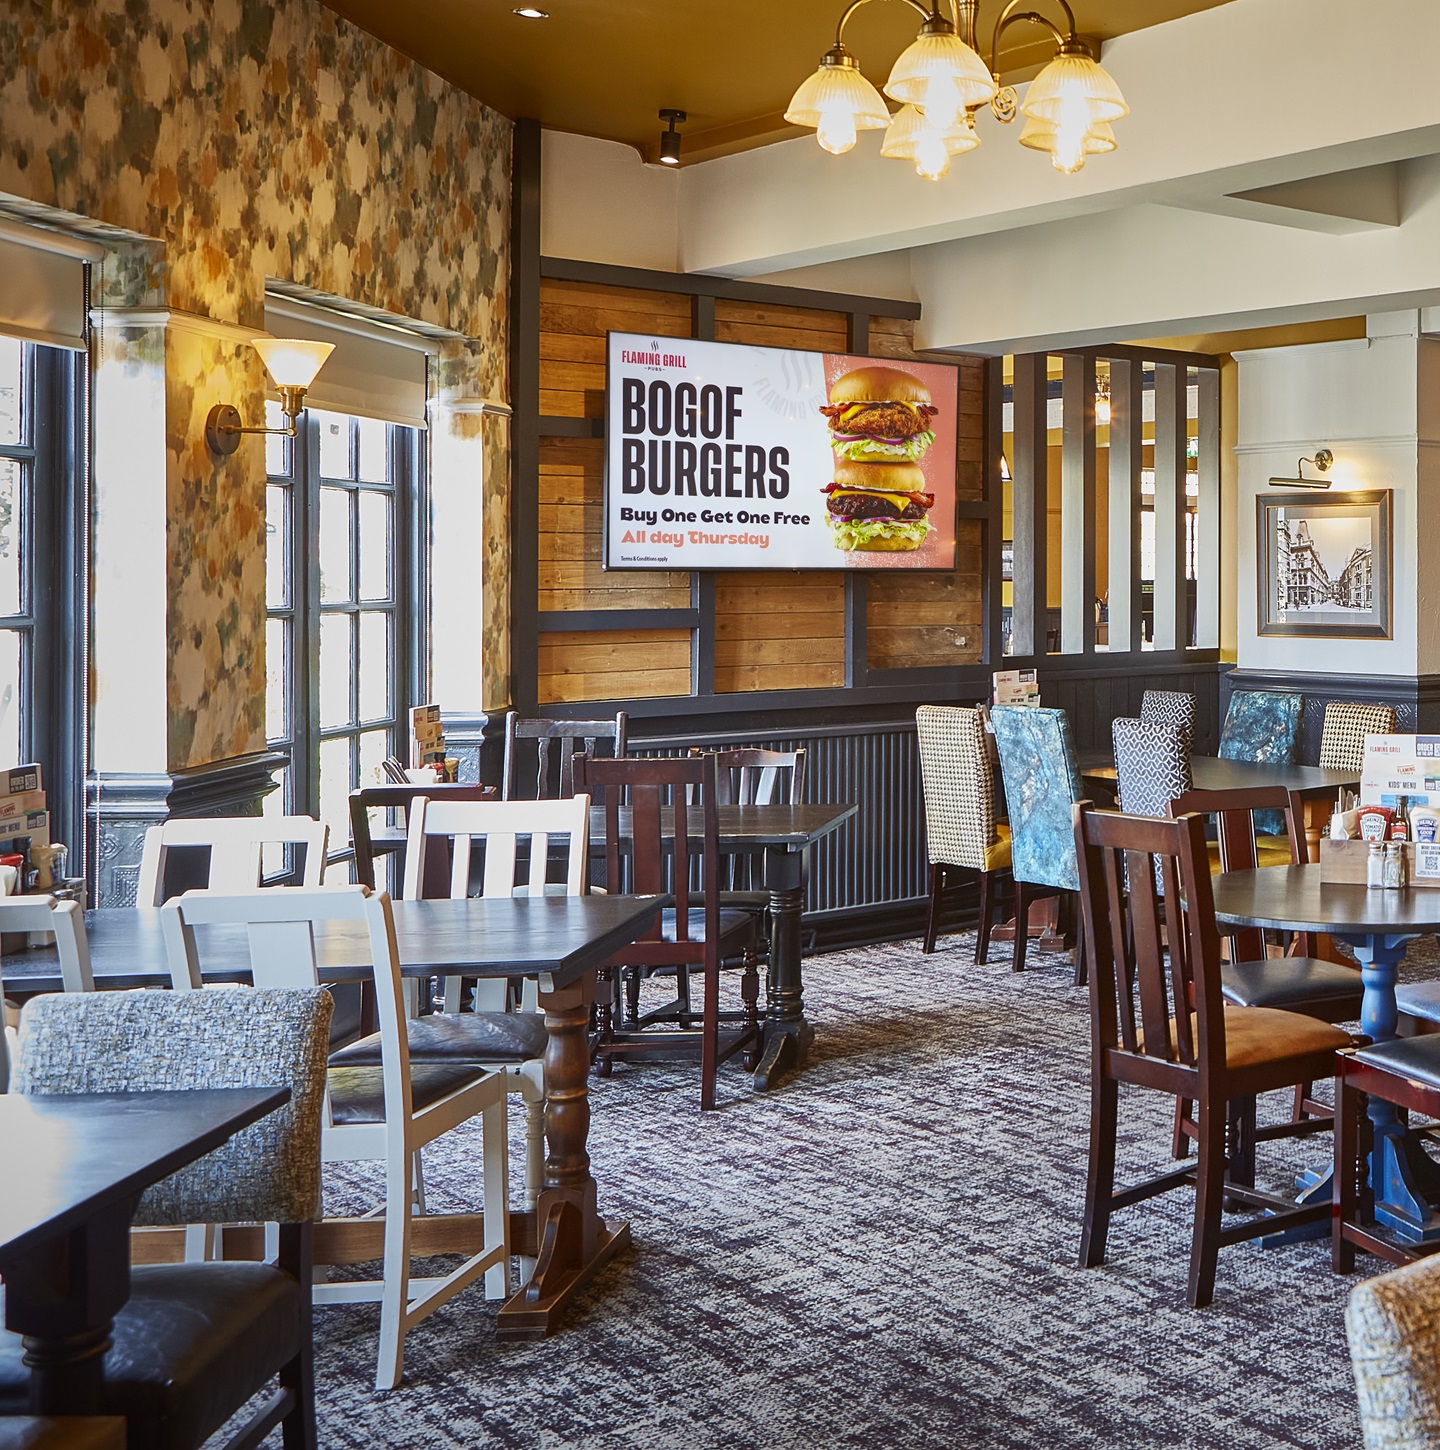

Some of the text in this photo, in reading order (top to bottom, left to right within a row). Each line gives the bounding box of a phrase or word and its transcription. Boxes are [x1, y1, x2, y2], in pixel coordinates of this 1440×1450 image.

[622, 350, 687, 368] FLAMING GRILL
[622, 377, 743, 440] BOGOF
[622, 438, 790, 499] BURGERS
[620, 507, 811, 525] Buy One Get One Free
[621, 530, 770, 548] All day Thursday
